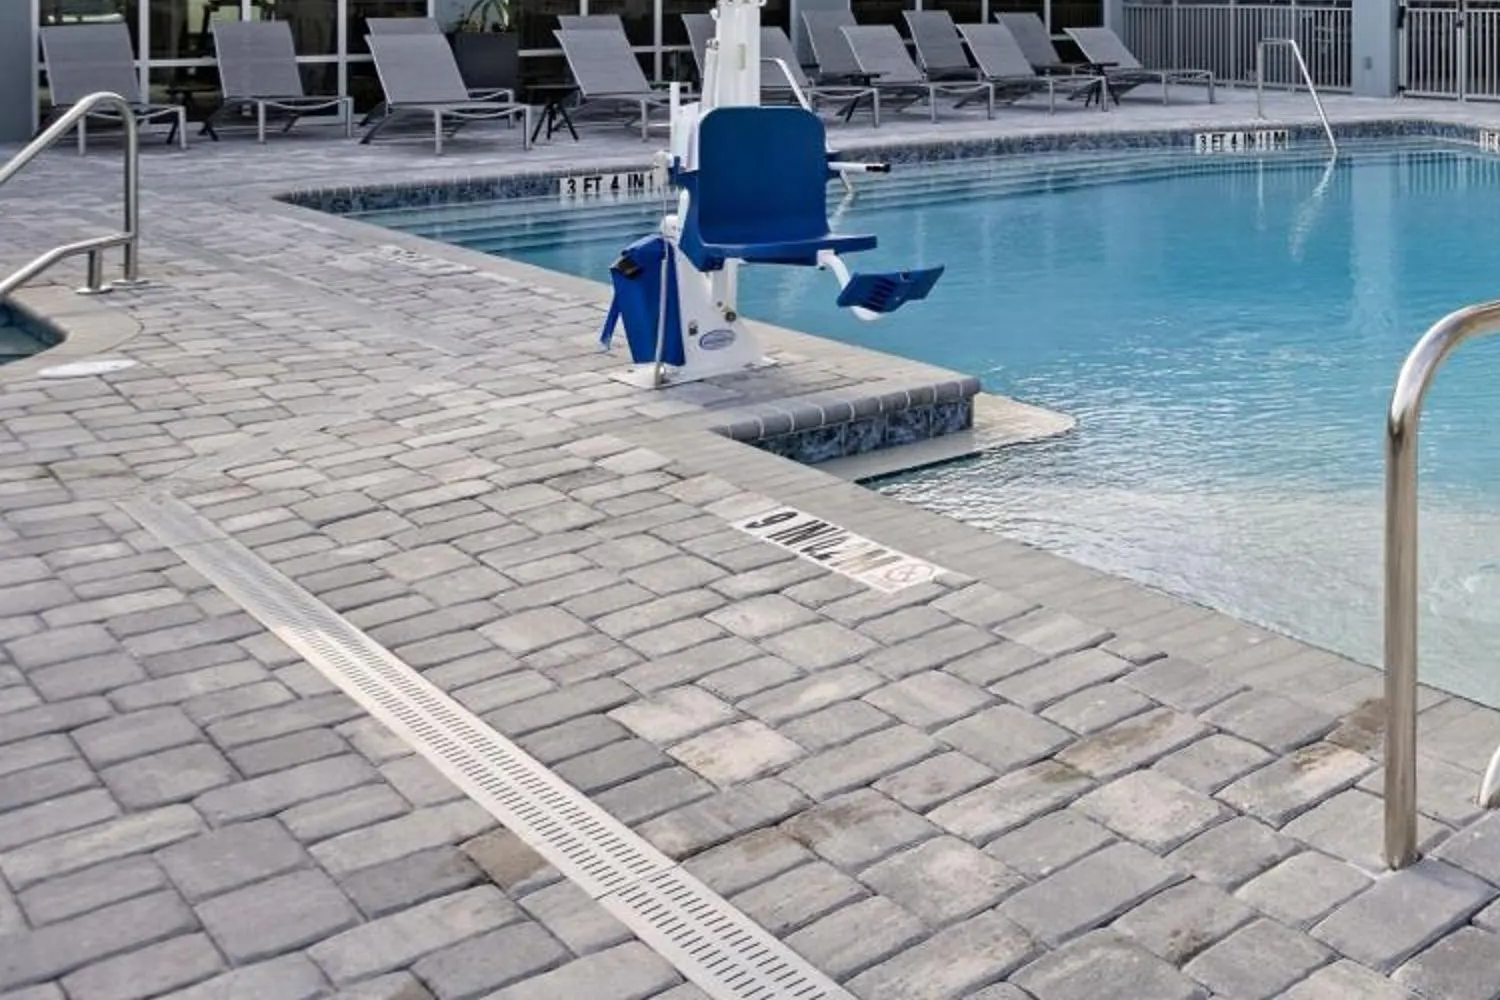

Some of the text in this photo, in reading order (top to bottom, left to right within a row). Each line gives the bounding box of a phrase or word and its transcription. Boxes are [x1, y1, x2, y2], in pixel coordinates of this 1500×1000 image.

[567, 178, 577, 193] 3
[583, 176, 602, 192] FT
[610, 175, 619, 190] 4
[627, 173, 644, 189] IN
[745, 511, 798, 528] 9
[766, 519, 837, 545] IN
